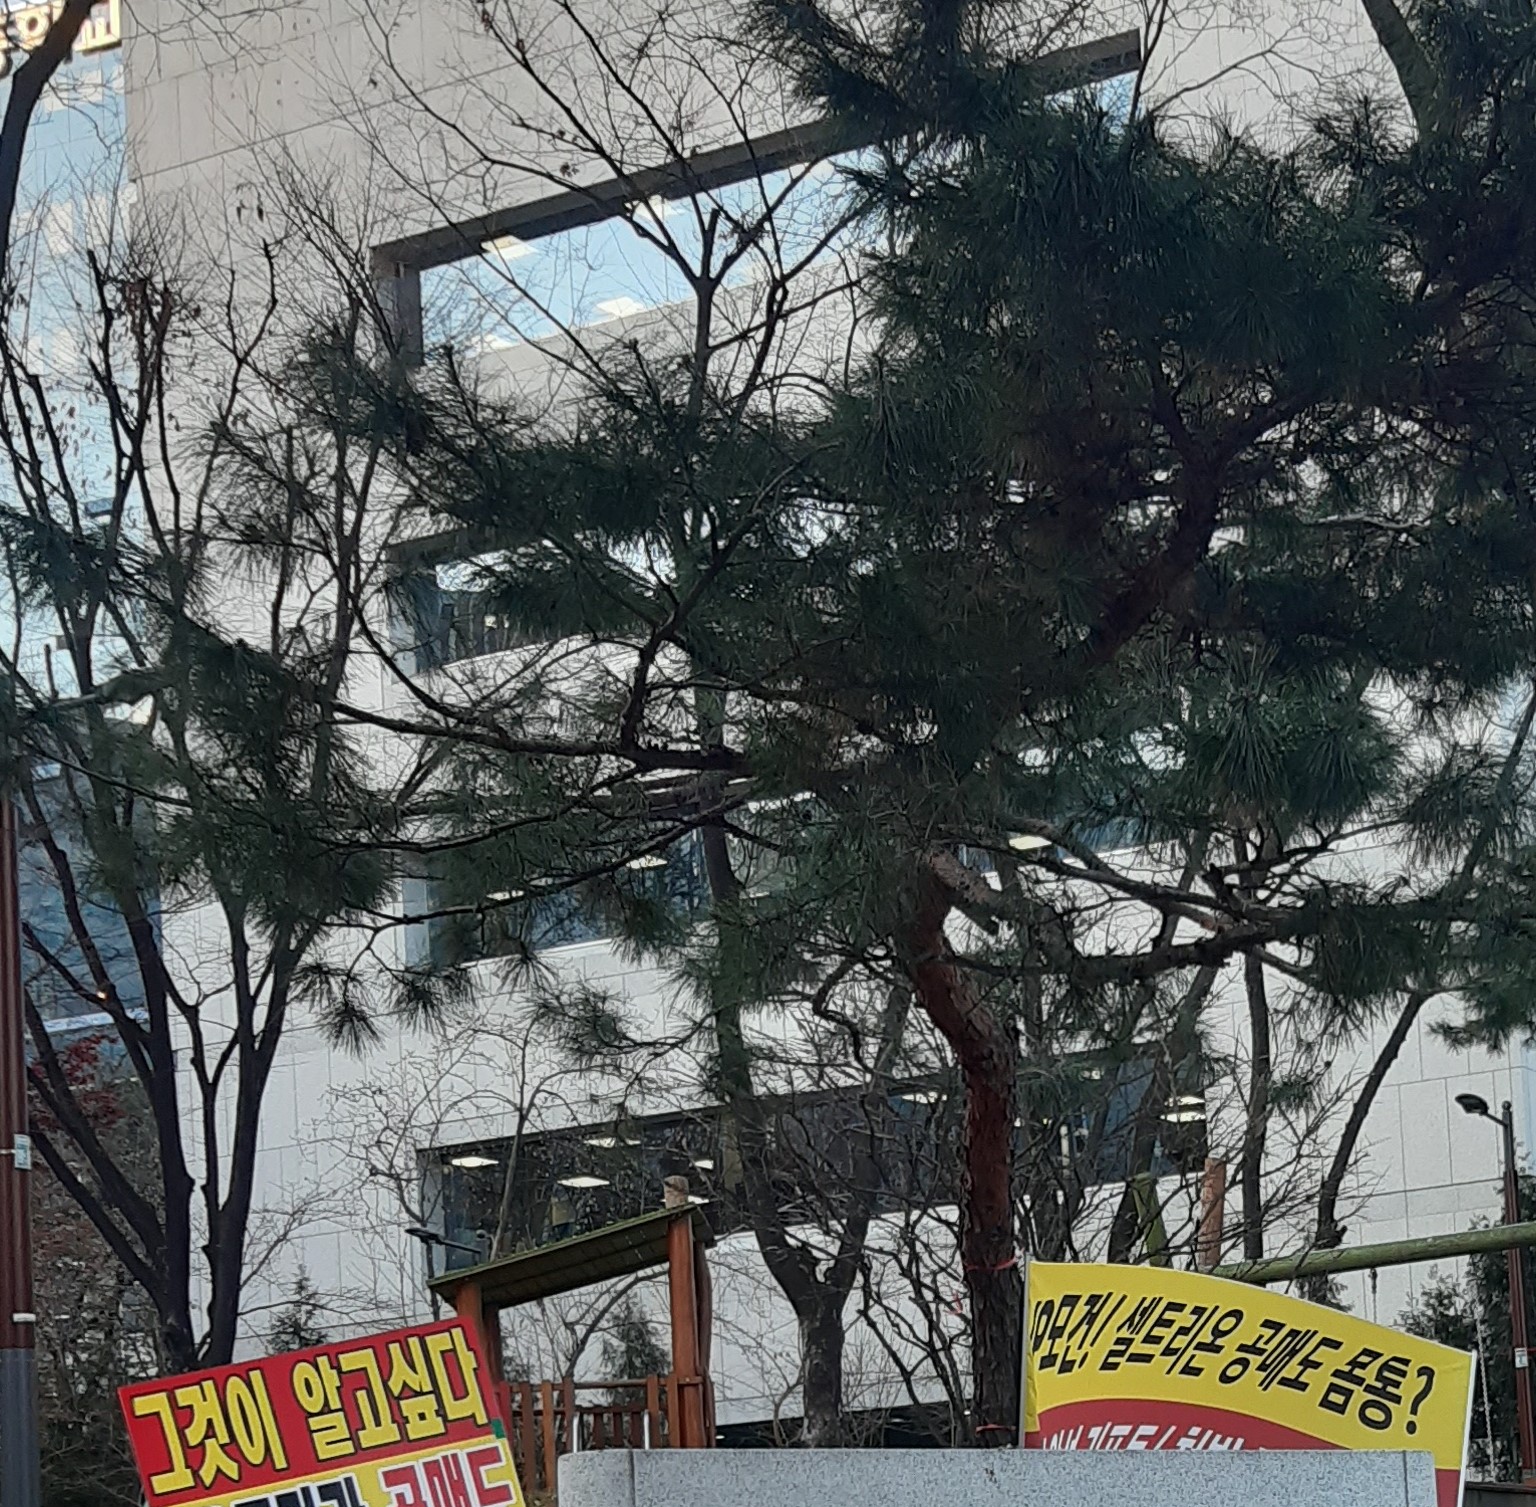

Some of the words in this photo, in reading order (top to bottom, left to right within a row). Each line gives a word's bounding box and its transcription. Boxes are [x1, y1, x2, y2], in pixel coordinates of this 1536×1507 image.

[132, 1368, 289, 1495] 그것이
[292, 1326, 490, 1462] 알고싶다
[1098, 1296, 1244, 1378] 셀트리온
[1217, 1318, 1344, 1393] 공매도
[1317, 1347, 1436, 1436] 몸통?
